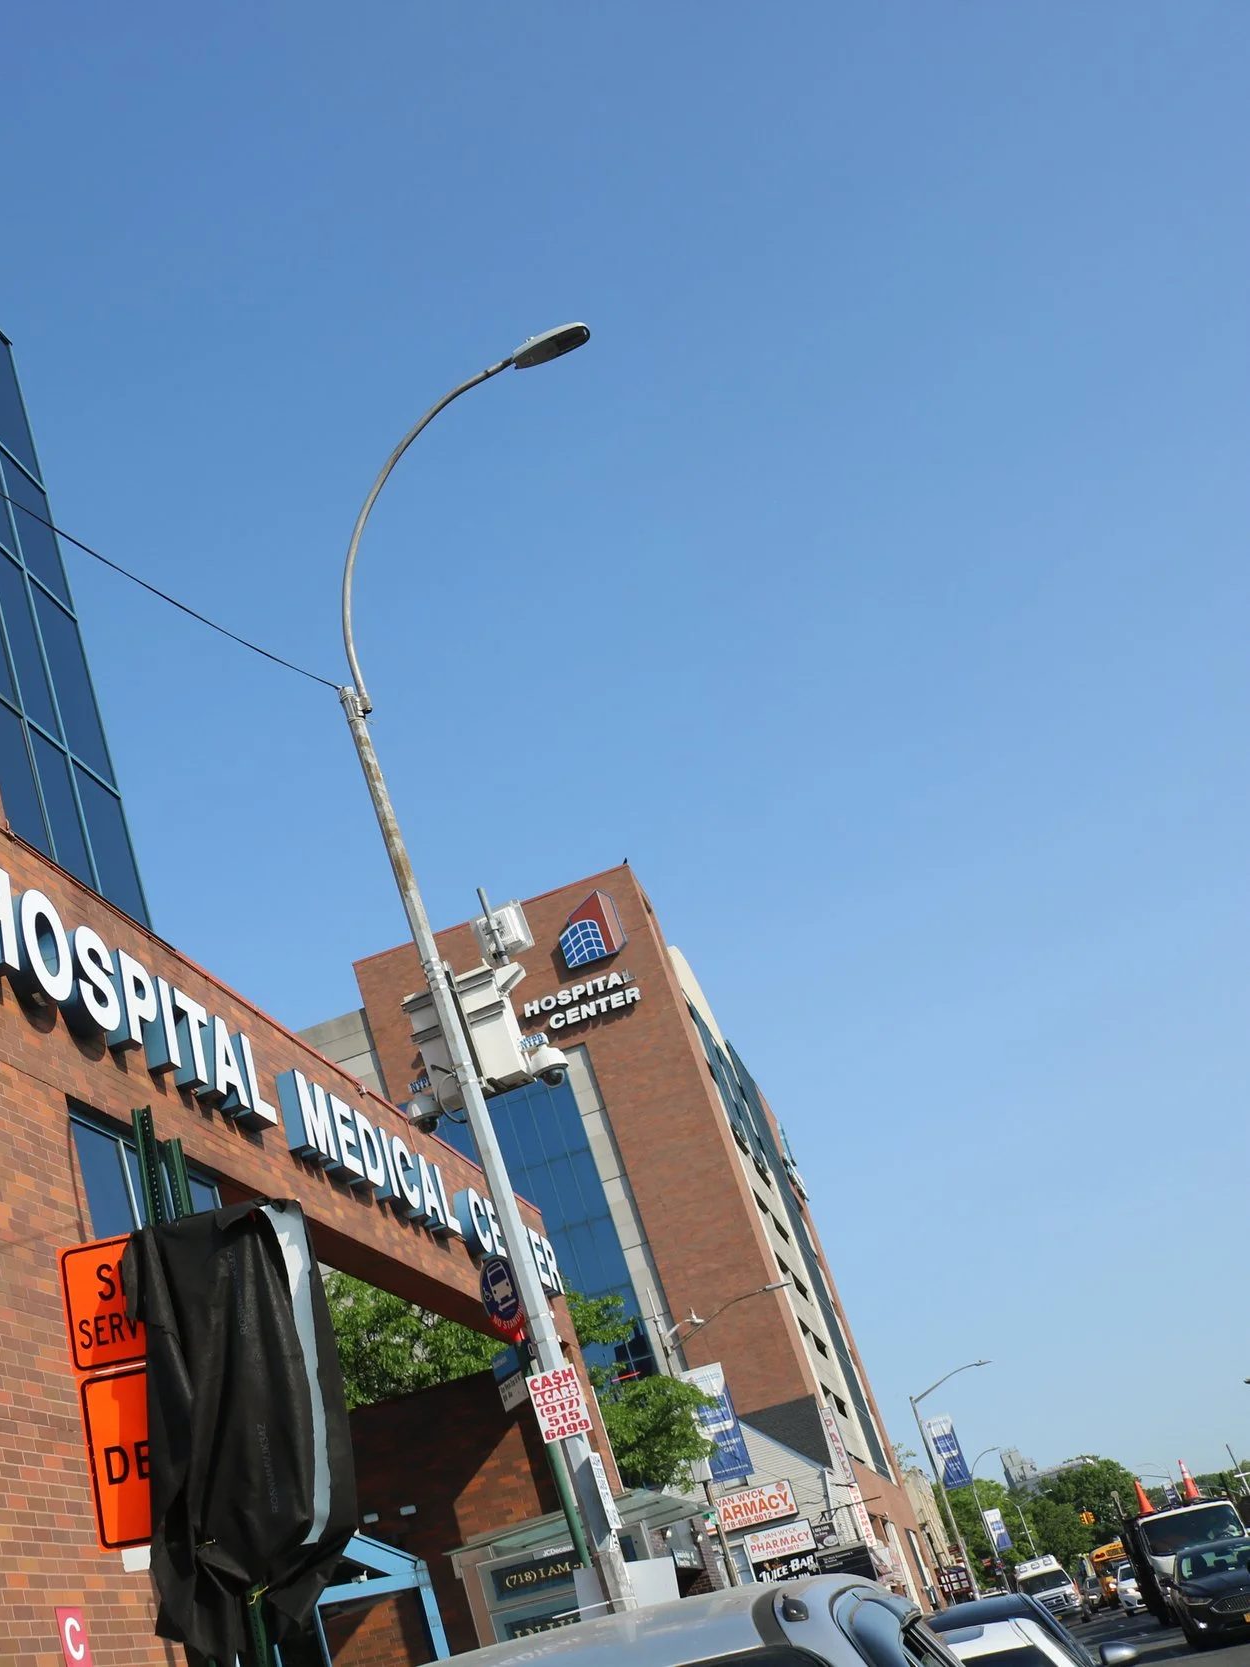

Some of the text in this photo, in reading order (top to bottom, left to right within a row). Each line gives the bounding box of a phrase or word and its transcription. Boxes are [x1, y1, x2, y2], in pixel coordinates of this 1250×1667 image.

[524, 968, 637, 1018] HOSPITAL
[549, 986, 642, 1030] CENTER
[519, 1033, 544, 1050] NYPD
[293, 1068, 463, 1236] MEDICAL
[466, 1187, 565, 1295] CEER
[529, 1367, 575, 1391] CA$H
[540, 1398, 580, 1418] (917)
[548, 1411, 581, 1427] 515
[544, 1419, 590, 1441] 6499
[716, 1488, 766, 1508] VAN WYCK
[722, 1491, 790, 1523] ARMACY
[853, 1494, 874, 1545] PHARMACY
[750, 1530, 811, 1554] PHARMACY
[763, 1526, 798, 1540] VAN WYCK
[505, 1570, 537, 1588] (718)
[538, 1569, 546, 1578] I
[548, 1561, 571, 1576] AM
[790, 1554, 816, 1574] BAR
[64, 1617, 84, 1661] C
